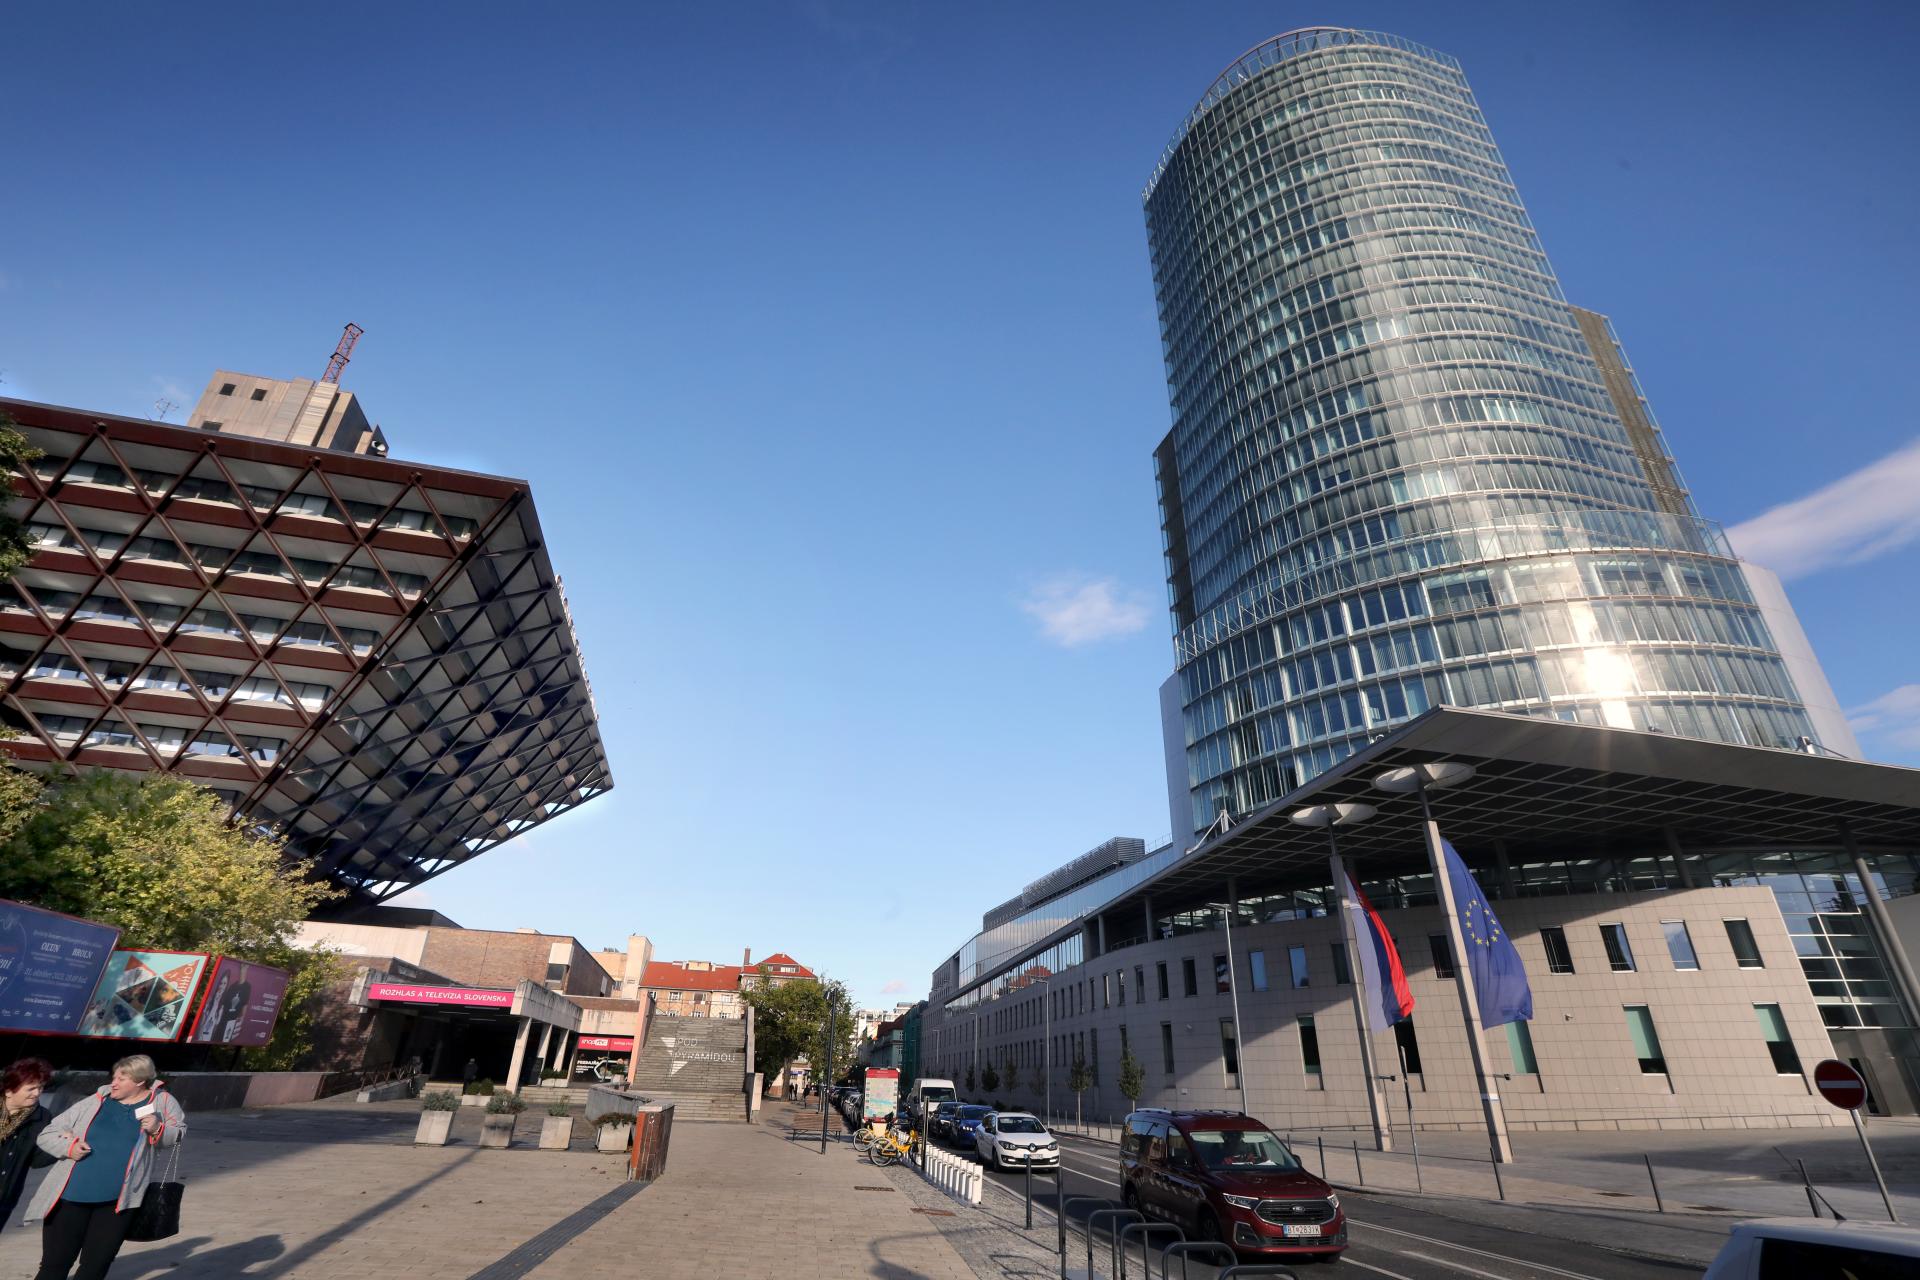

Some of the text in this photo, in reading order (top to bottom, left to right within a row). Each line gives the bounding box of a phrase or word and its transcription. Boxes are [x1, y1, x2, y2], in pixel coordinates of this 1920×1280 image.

[379, 988, 416, 997] ROZHLAS
[425, 990, 462, 1000] TELEVÍZIA
[464, 994, 507, 1003] SLOVENSKA
[676, 1037, 698, 1047] POD
